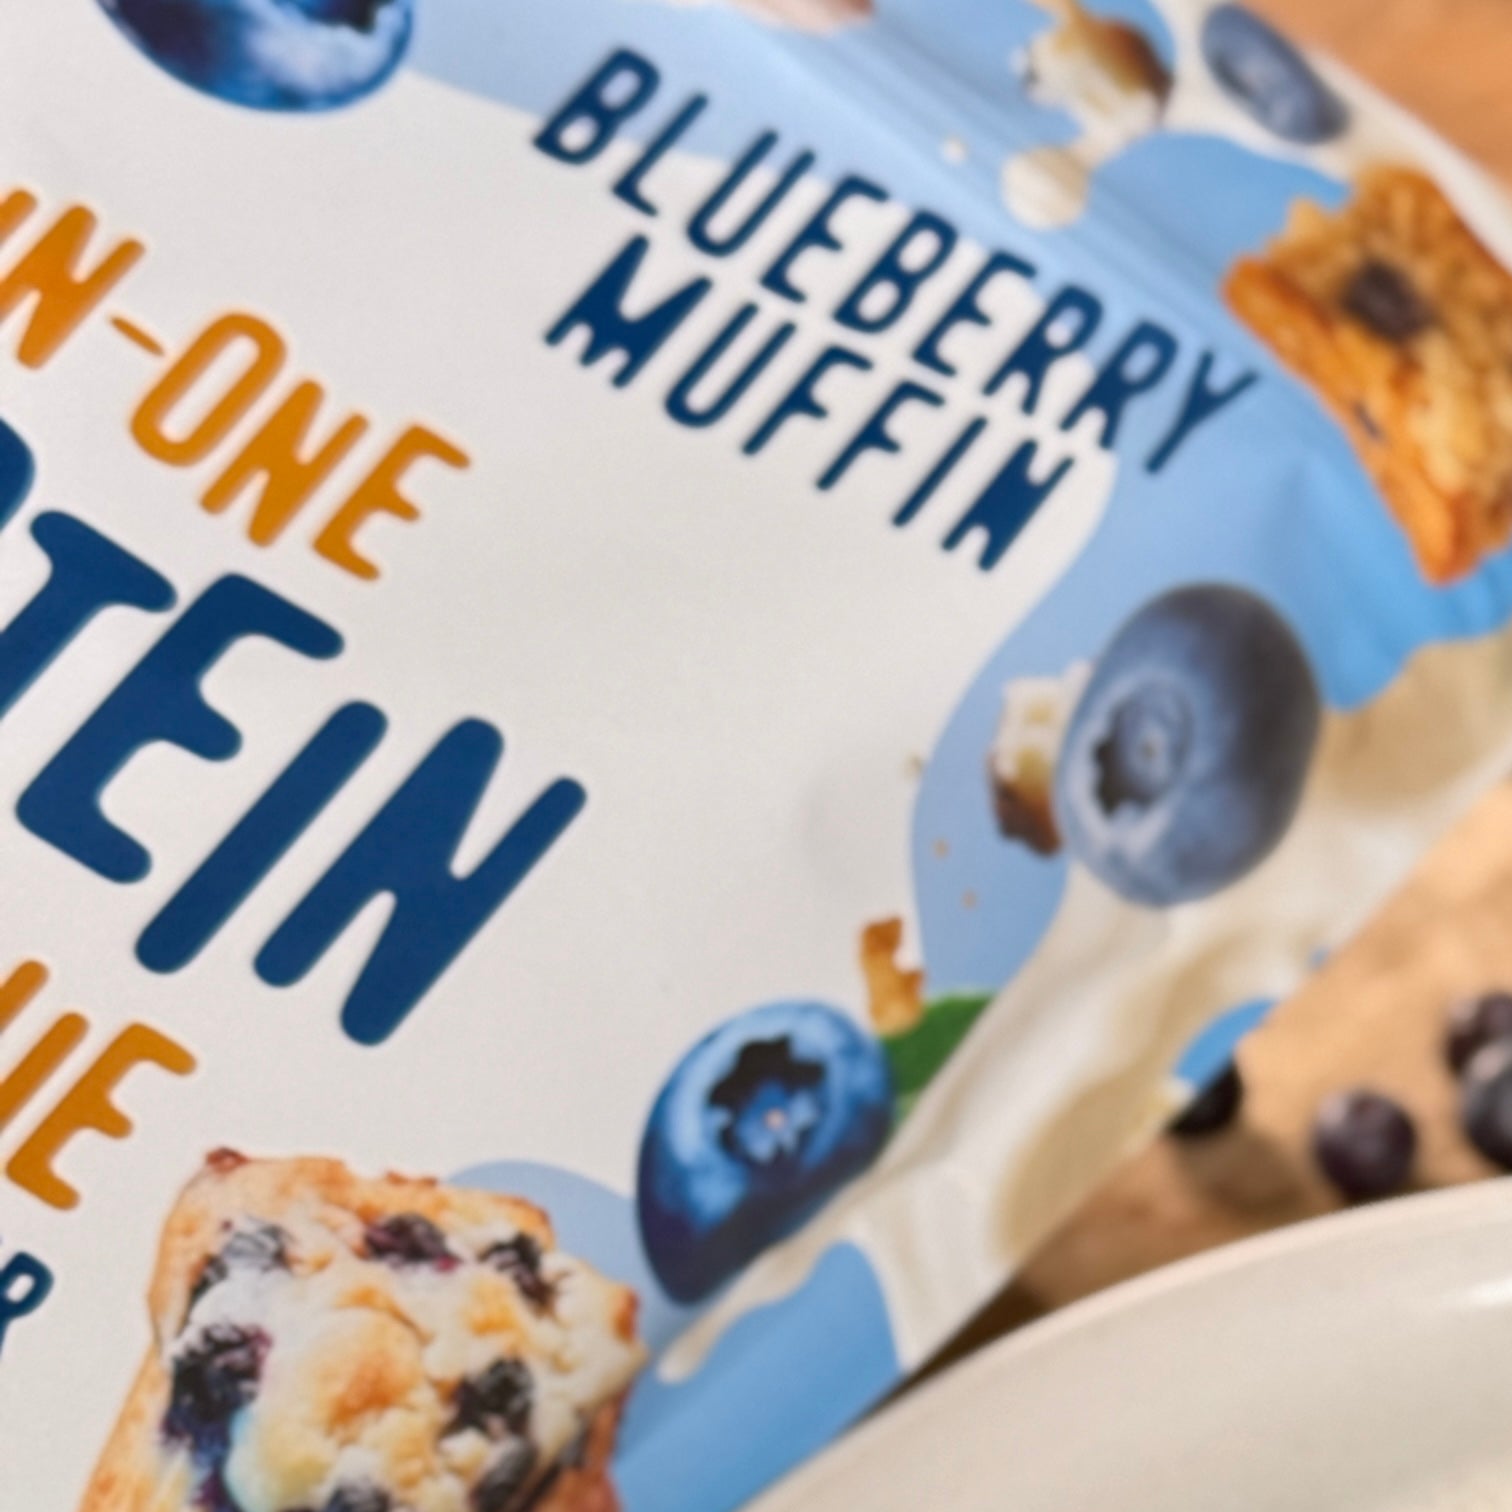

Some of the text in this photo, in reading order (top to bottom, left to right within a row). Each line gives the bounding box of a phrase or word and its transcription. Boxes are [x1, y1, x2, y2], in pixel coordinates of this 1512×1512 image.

[533, 47, 1259, 475] BLUEBERRY
[545, 234, 1073, 571] MUFFIN
[0, 414, 588, 1047] TEIN
